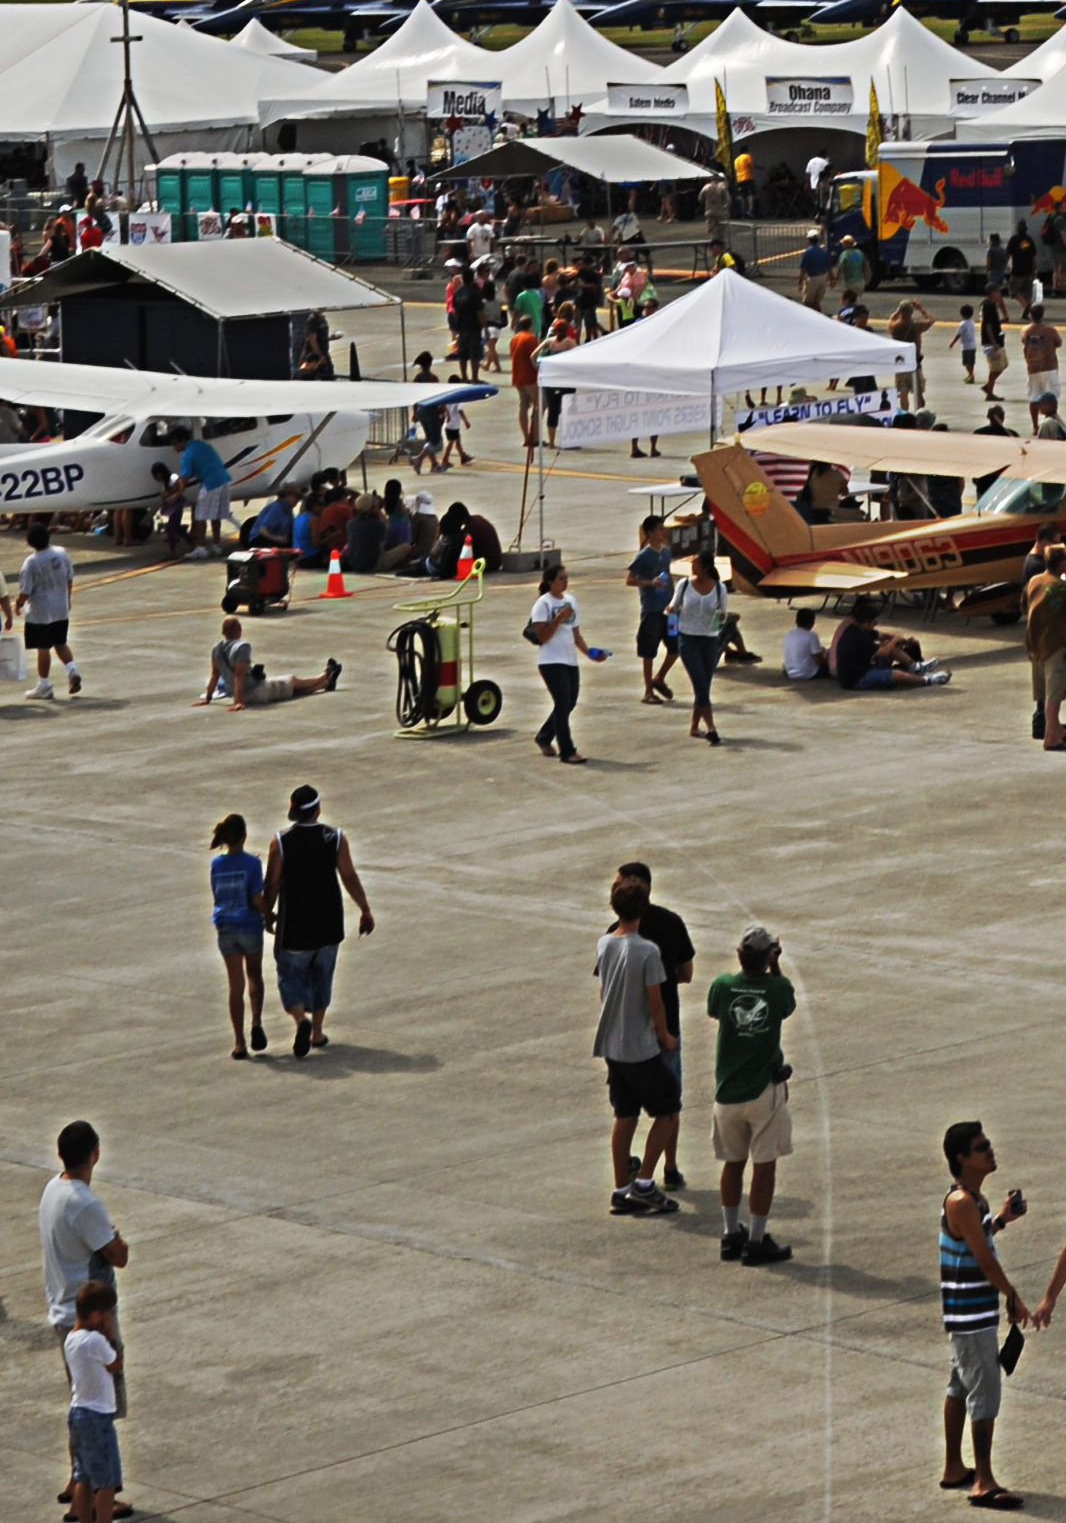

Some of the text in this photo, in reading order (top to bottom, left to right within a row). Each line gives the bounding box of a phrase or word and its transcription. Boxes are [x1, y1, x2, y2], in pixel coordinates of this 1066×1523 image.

[789, 85, 830, 100] Ohana
[957, 91, 978, 104] Clear
[982, 91, 1015, 104] Channel
[443, 90, 485, 116] Media
[769, 101, 852, 114] Broadcast Company
[951, 167, 1002, 187] Red Bull
[815, 400, 833, 418] TO
[0, 464, 84, 502] 22BP
